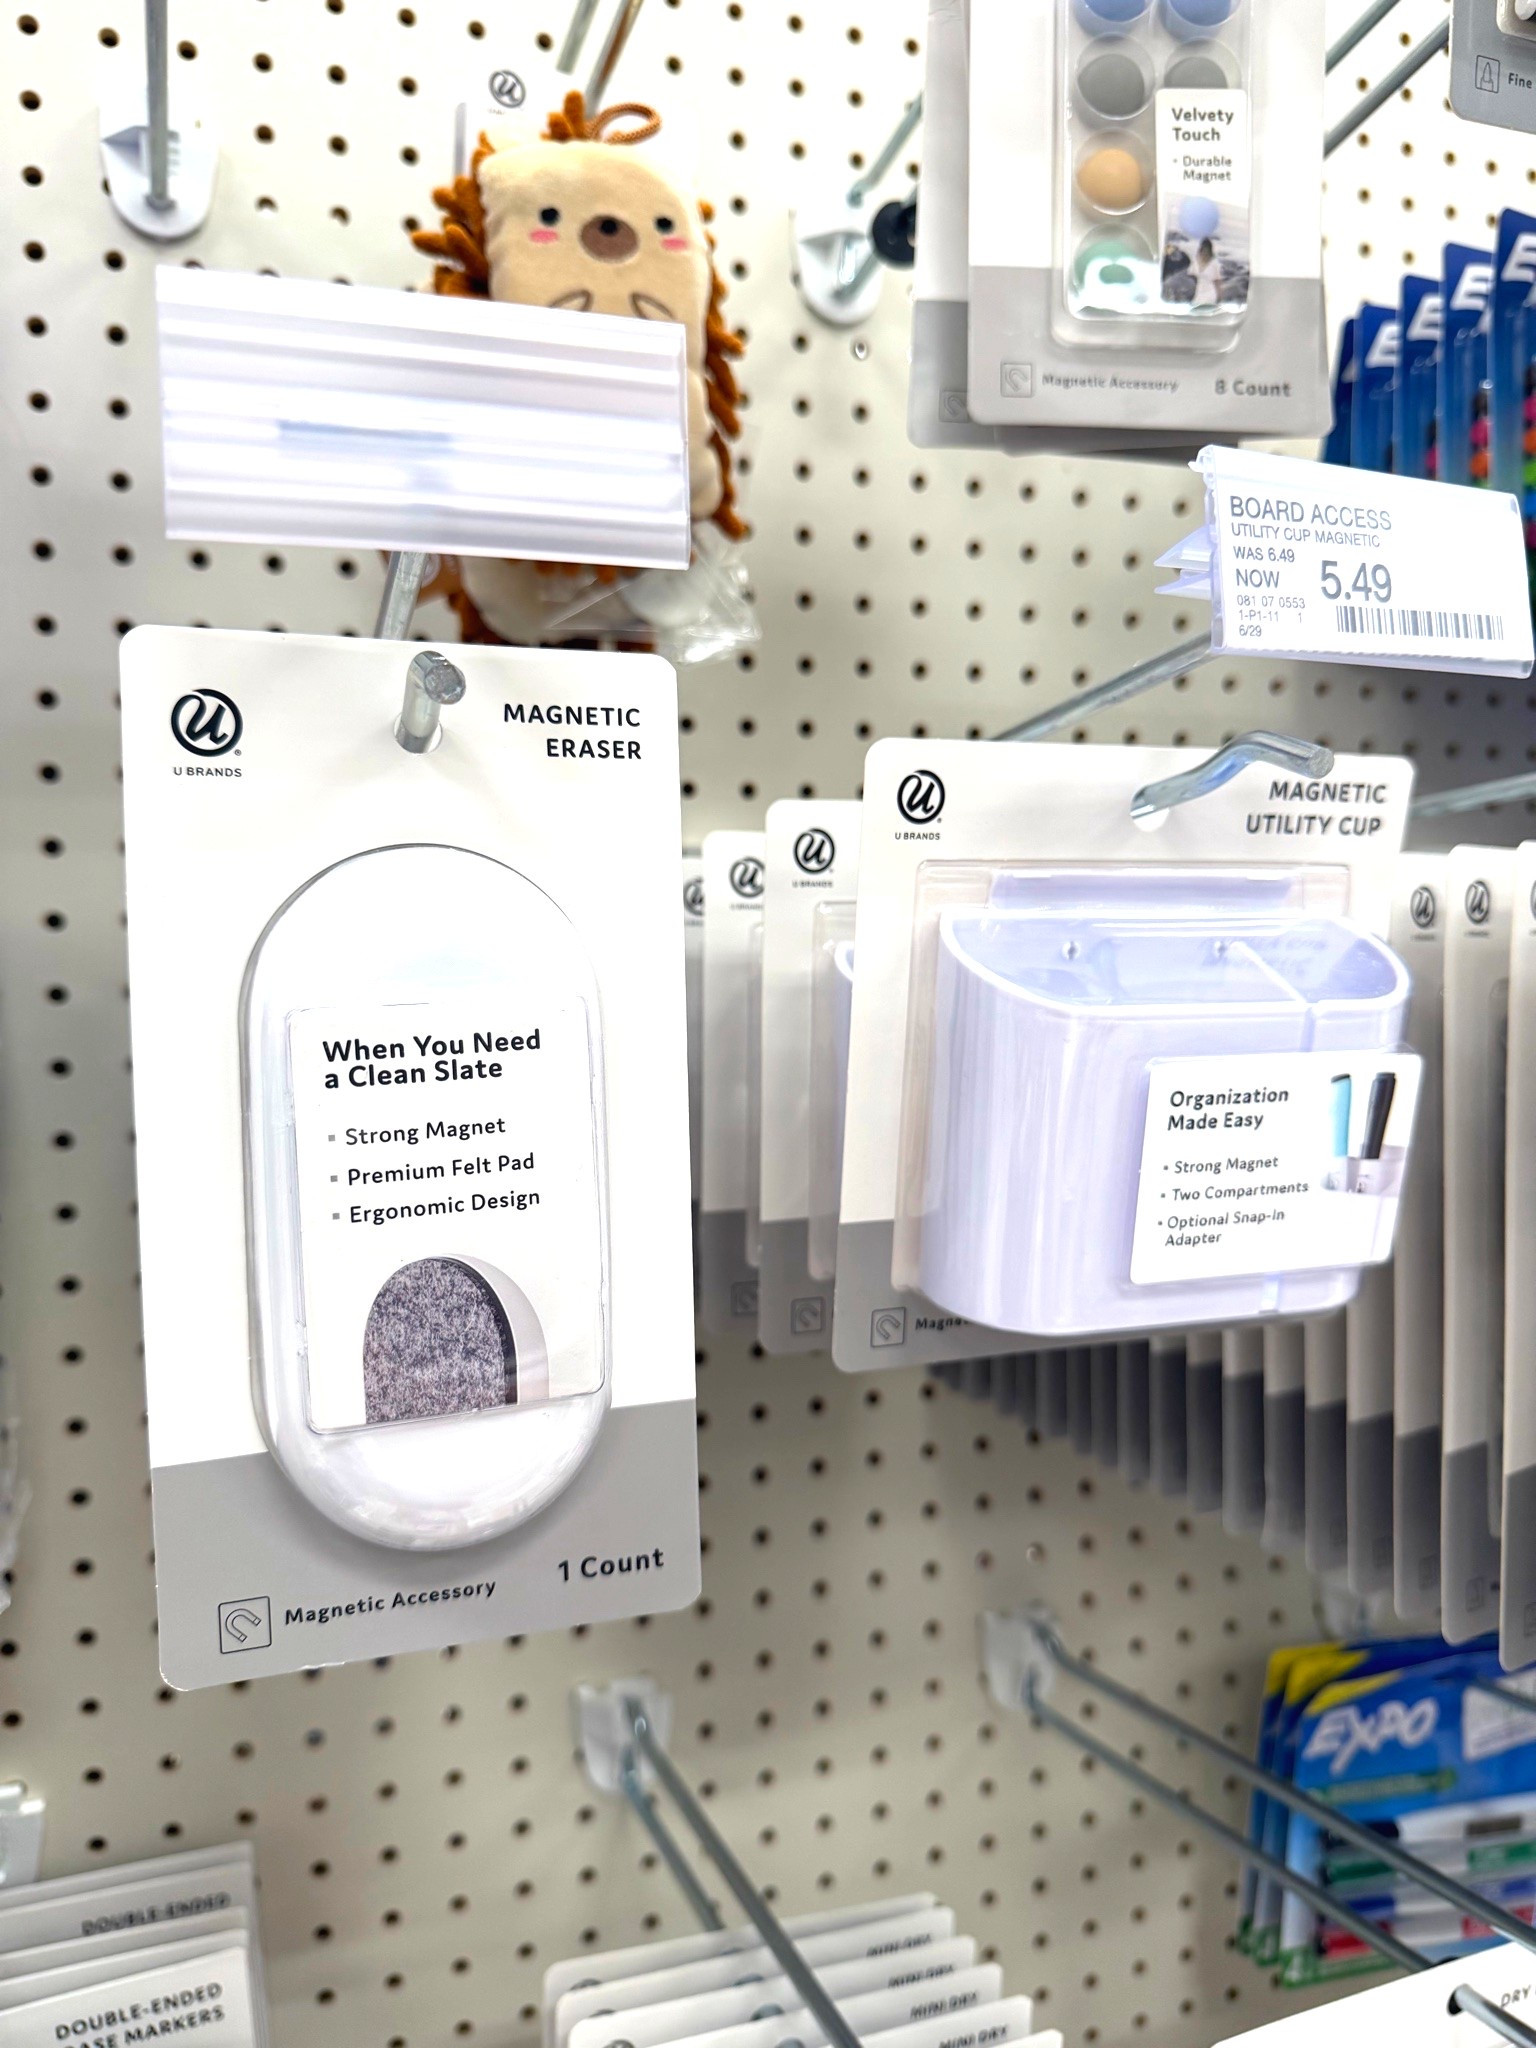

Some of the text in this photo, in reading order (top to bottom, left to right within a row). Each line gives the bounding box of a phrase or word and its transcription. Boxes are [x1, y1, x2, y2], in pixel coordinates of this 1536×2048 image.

[1508, 72, 1533, 89] Fine
[1171, 106, 1234, 126] Velvety
[1172, 127, 1221, 142] Touch
[1182, 155, 1232, 167] Durable
[1182, 169, 1232, 184] Magnet
[1041, 373, 1180, 394] Magnetic Accessory
[1214, 378, 1292, 397] 8 Count
[1230, 495, 1393, 531] BOARD ACCESS
[1231, 522, 1381, 548] UTILITY CUP MAGNETIC
[1233, 545, 1296, 564] WAS 6.49
[1235, 559, 1392, 603] NOW 5.49
[1237, 595, 1306, 610] 081 07 0553
[1238, 609, 1279, 623] 1-P1-11
[1238, 624, 1263, 638] 6/29
[503, 702, 642, 728] MAGNETIC
[545, 737, 642, 760] ERASER
[173, 766, 242, 778] U BRANDS
[1268, 780, 1388, 804] MAGNETIC
[1246, 813, 1382, 836] UTILITY CUP
[895, 832, 941, 841] U BRANDS
[322, 1028, 541, 1062] When You Need
[324, 1058, 503, 1089] a Clean Slate
[1170, 1087, 1290, 1110] Organization
[1167, 1111, 1265, 1131] Made Easy
[345, 1118, 506, 1146] Strong Magnet
[348, 1152, 535, 1186] Premium Felt Pad
[1174, 1156, 1279, 1175] Strong Magnet
[1172, 1181, 1309, 1201] Two Compartments
[350, 1190, 540, 1226] Ergonomic Design
[1167, 1212, 1229, 1230] Optional
[1165, 1231, 1221, 1247] Adapter
[916, 1317, 968, 1331] Magne
[557, 1547, 665, 1582] 1 Count
[284, 1579, 497, 1626] Magnetic Accessory
[1301, 1697, 1438, 1776] EXPO
[55, 1982, 223, 2041] DOUBLE-ENDED
[124, 2004, 226, 2046] MARKERS
